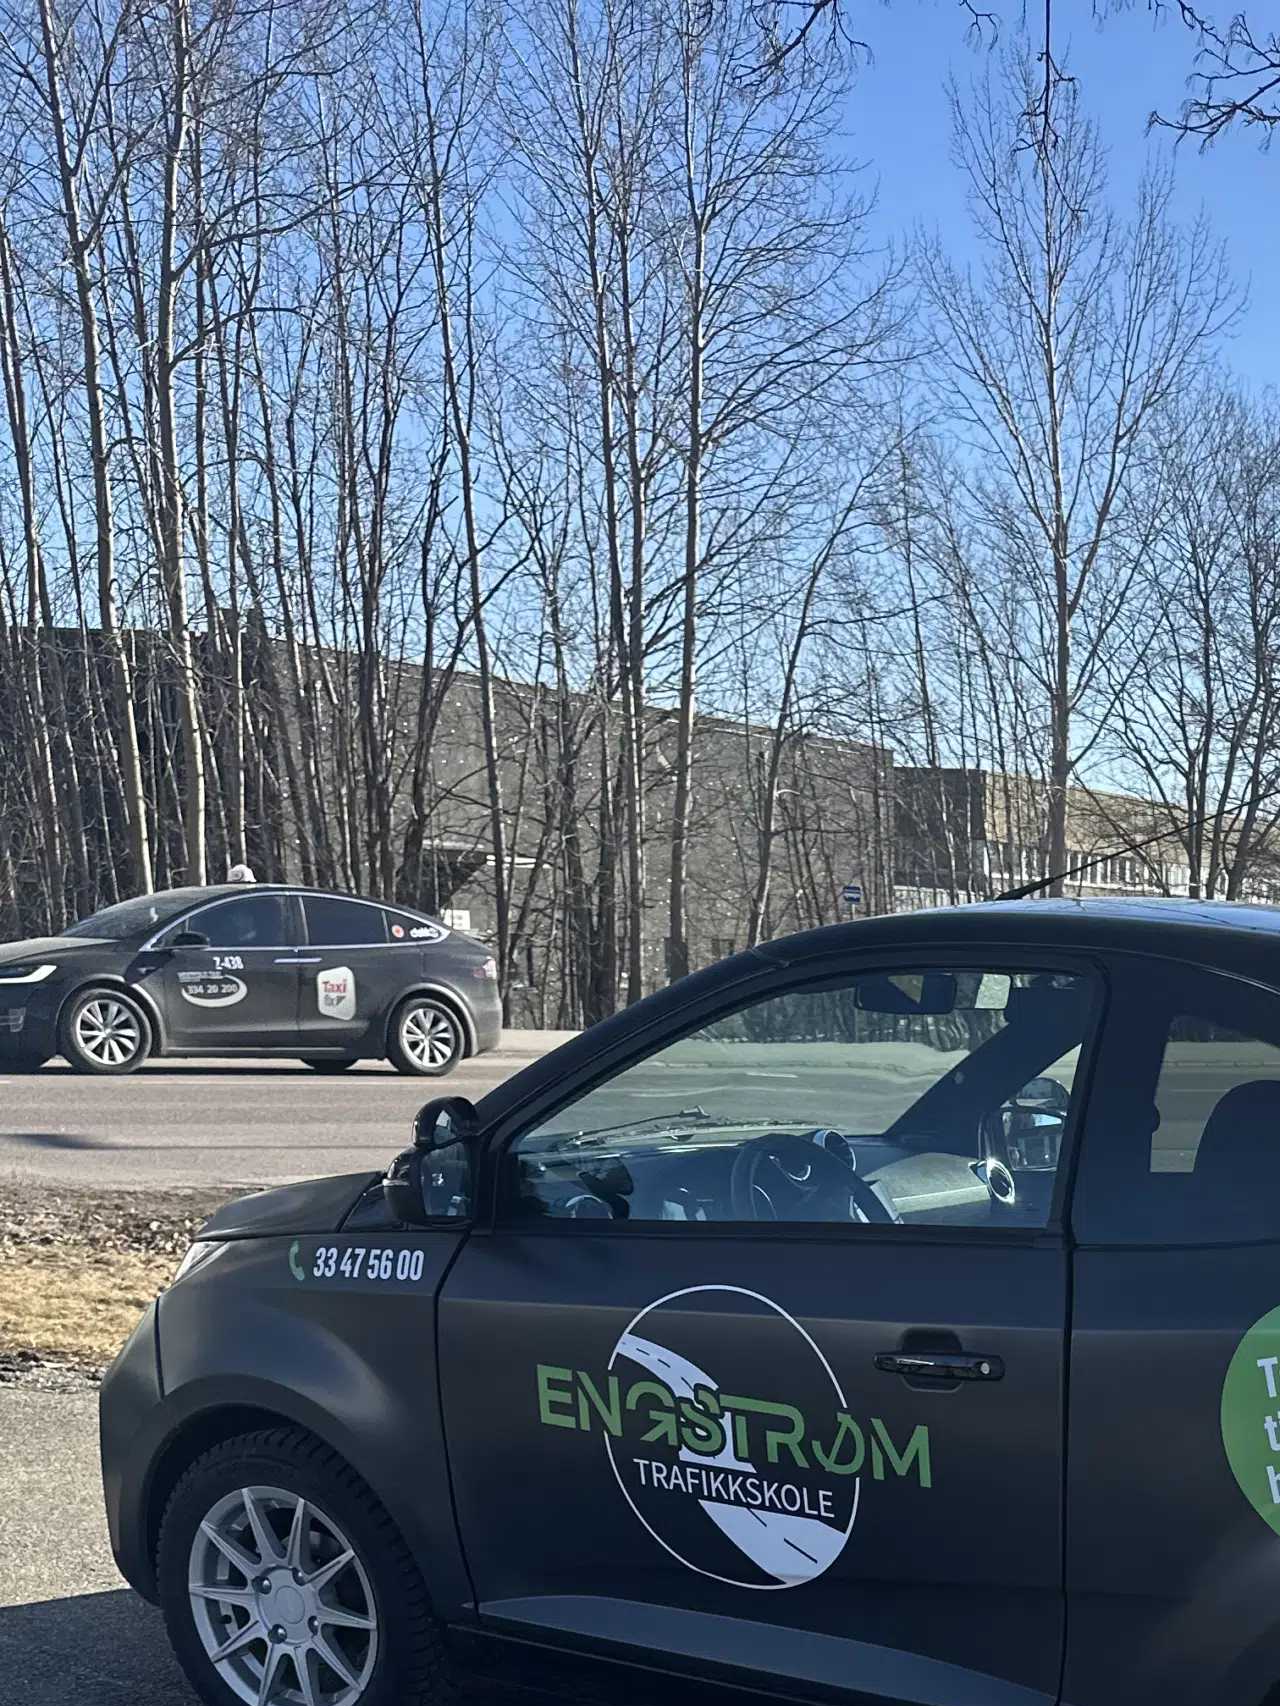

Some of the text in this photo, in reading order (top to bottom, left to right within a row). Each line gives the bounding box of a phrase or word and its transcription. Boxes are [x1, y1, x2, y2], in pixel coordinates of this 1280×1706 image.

[322, 977, 348, 993] Taxi
[313, 1247, 425, 1281] 33 47 56 00
[536, 1363, 932, 1489] ENGSTRØM
[632, 1457, 836, 1518] TRAFIKKSKOLE
